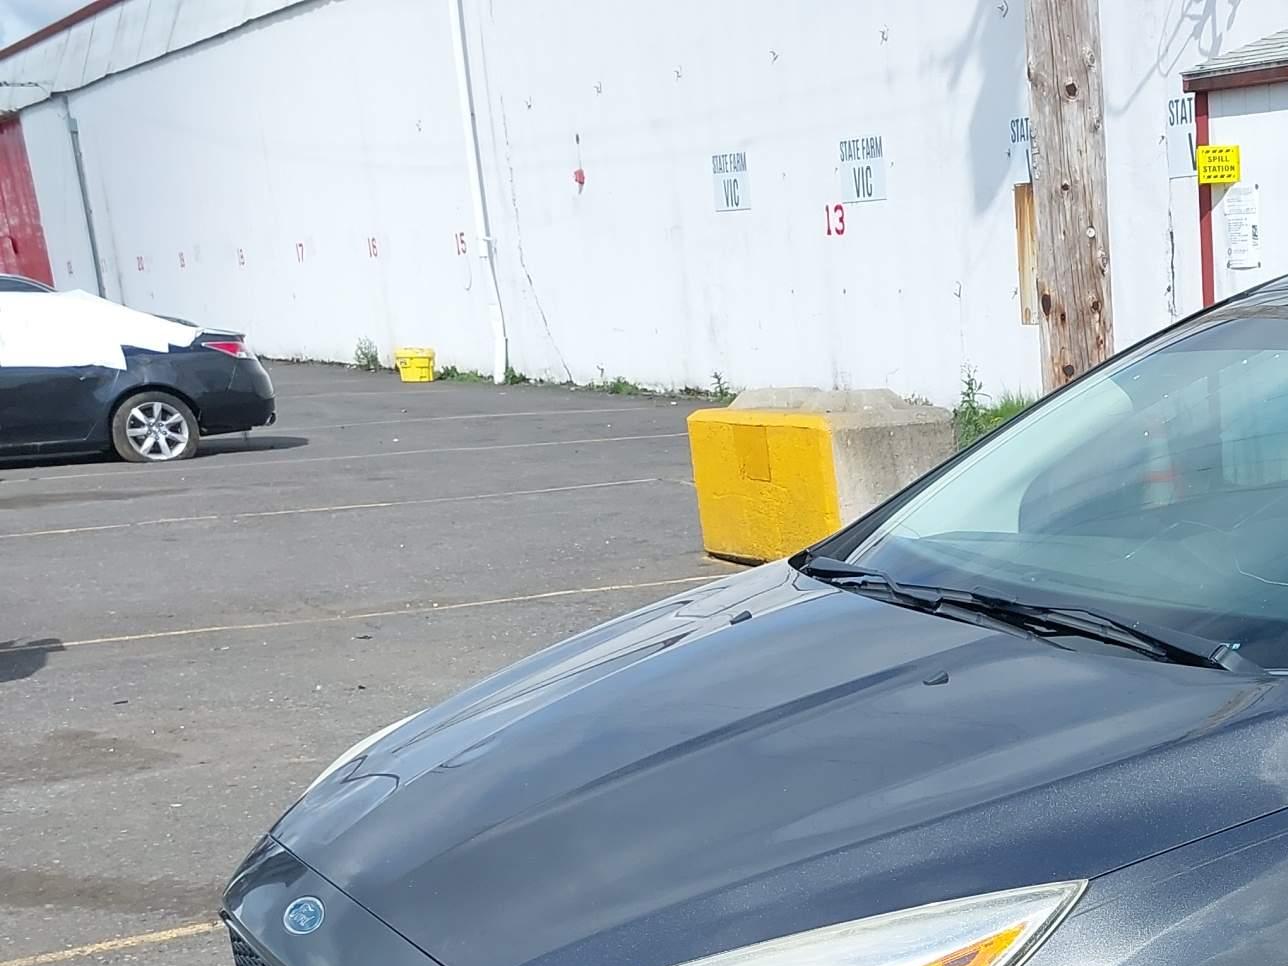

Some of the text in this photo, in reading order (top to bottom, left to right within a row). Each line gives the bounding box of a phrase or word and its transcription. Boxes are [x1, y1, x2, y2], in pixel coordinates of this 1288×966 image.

[1168, 97, 1193, 126] STAT
[1010, 117, 1030, 143] STAT
[839, 136, 883, 162] STATE FARM
[712, 151, 747, 174] STATE FARM
[1203, 165, 1235, 173] STATION
[723, 178, 740, 208] VIC
[853, 165, 873, 198] VIC
[825, 204, 845, 236] 13
[296, 243, 303, 264] 17
[455, 232, 467, 256] 15
